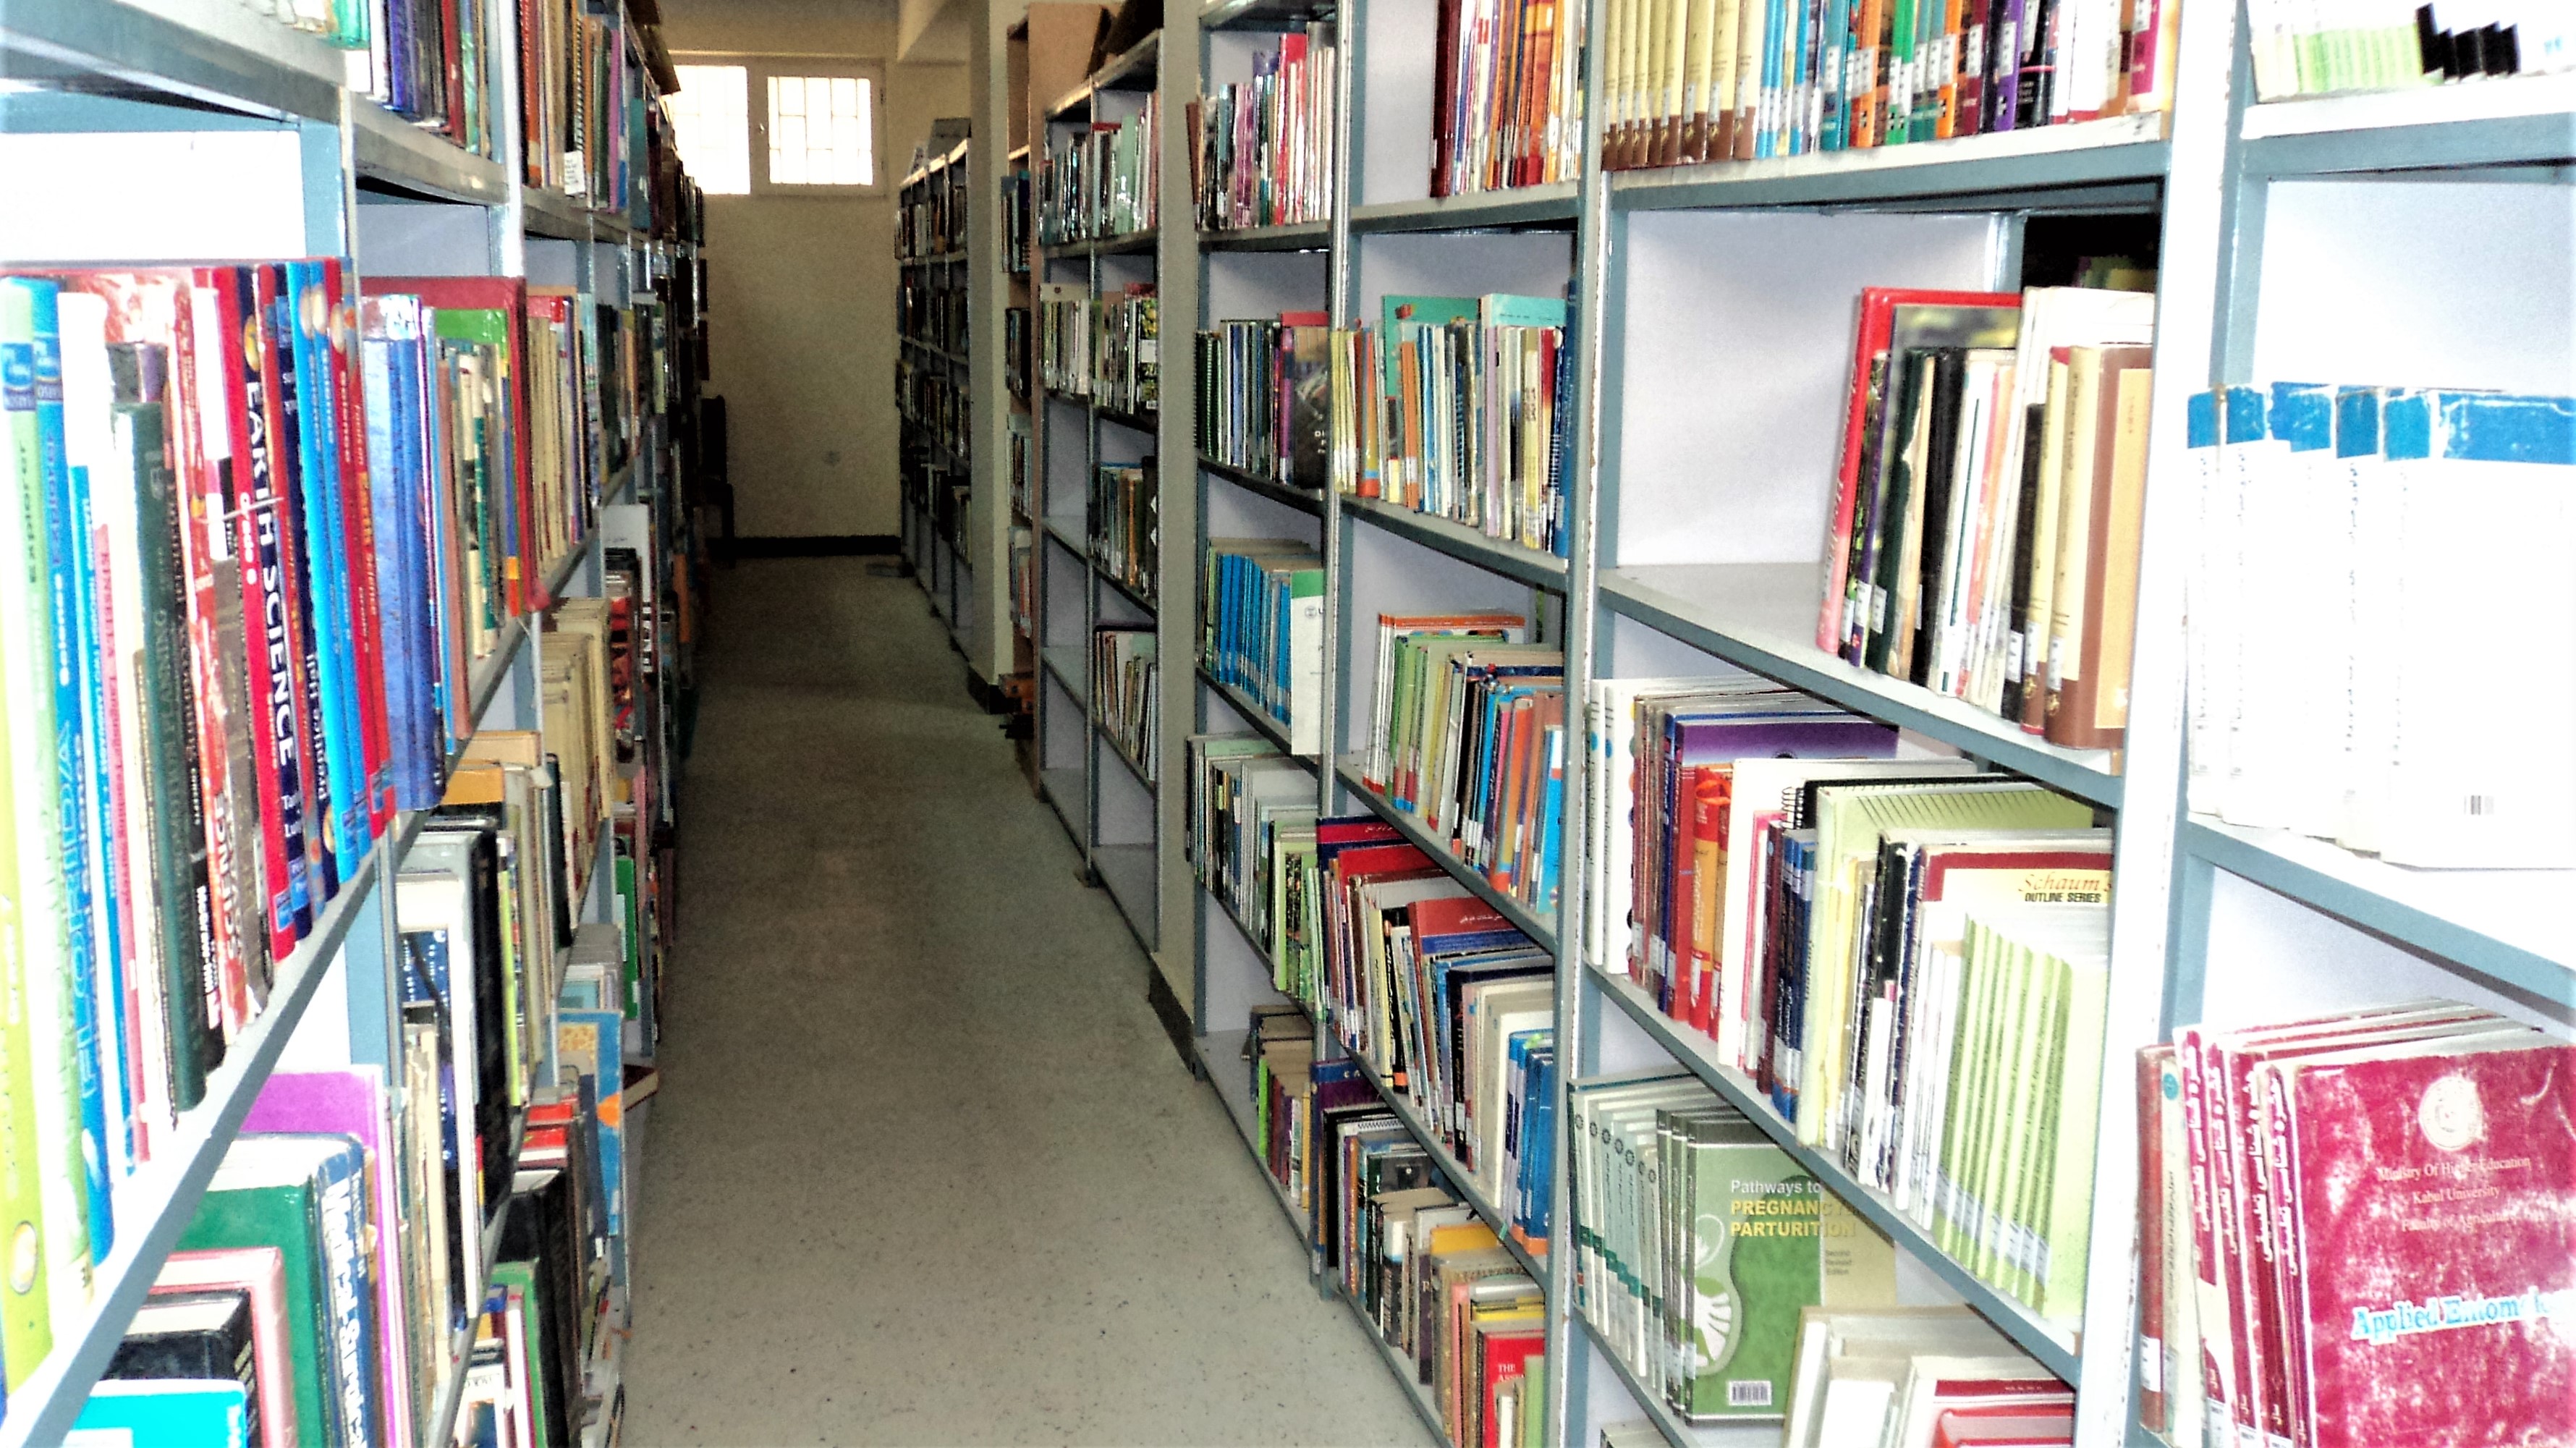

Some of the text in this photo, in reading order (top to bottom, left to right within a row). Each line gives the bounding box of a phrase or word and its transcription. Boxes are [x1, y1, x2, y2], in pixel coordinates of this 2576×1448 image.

[19, 441, 36, 583] Explorer
[239, 492, 255, 562] Grade
[45, 431, 70, 686] Science Explorer
[245, 382, 274, 545] EARTH
[262, 564, 296, 765] SCIENCE
[88, 576, 99, 644] THROUGH
[101, 551, 117, 658] KINSELLA
[109, 676, 124, 755] Language
[306, 655, 327, 799] Prentice Hall
[115, 763, 127, 837] Teaching
[58, 721, 98, 1098] FLORIDA
[215, 792, 242, 958] SCIENCE
[2025, 892, 2101, 903] OUTLINE SERIES
[1732, 1180, 1822, 1196] Pathways to
[2376, 1157, 2531, 1182] Ministry Of Hier Education
[2412, 1185, 2500, 1204] Kabul University
[1730, 1221, 1857, 1237] PARTURITION
[321, 1177, 368, 1448] Medical-Surgical
[2354, 1297, 2439, 1339] Applied
[1499, 1363, 1515, 1373] THE
